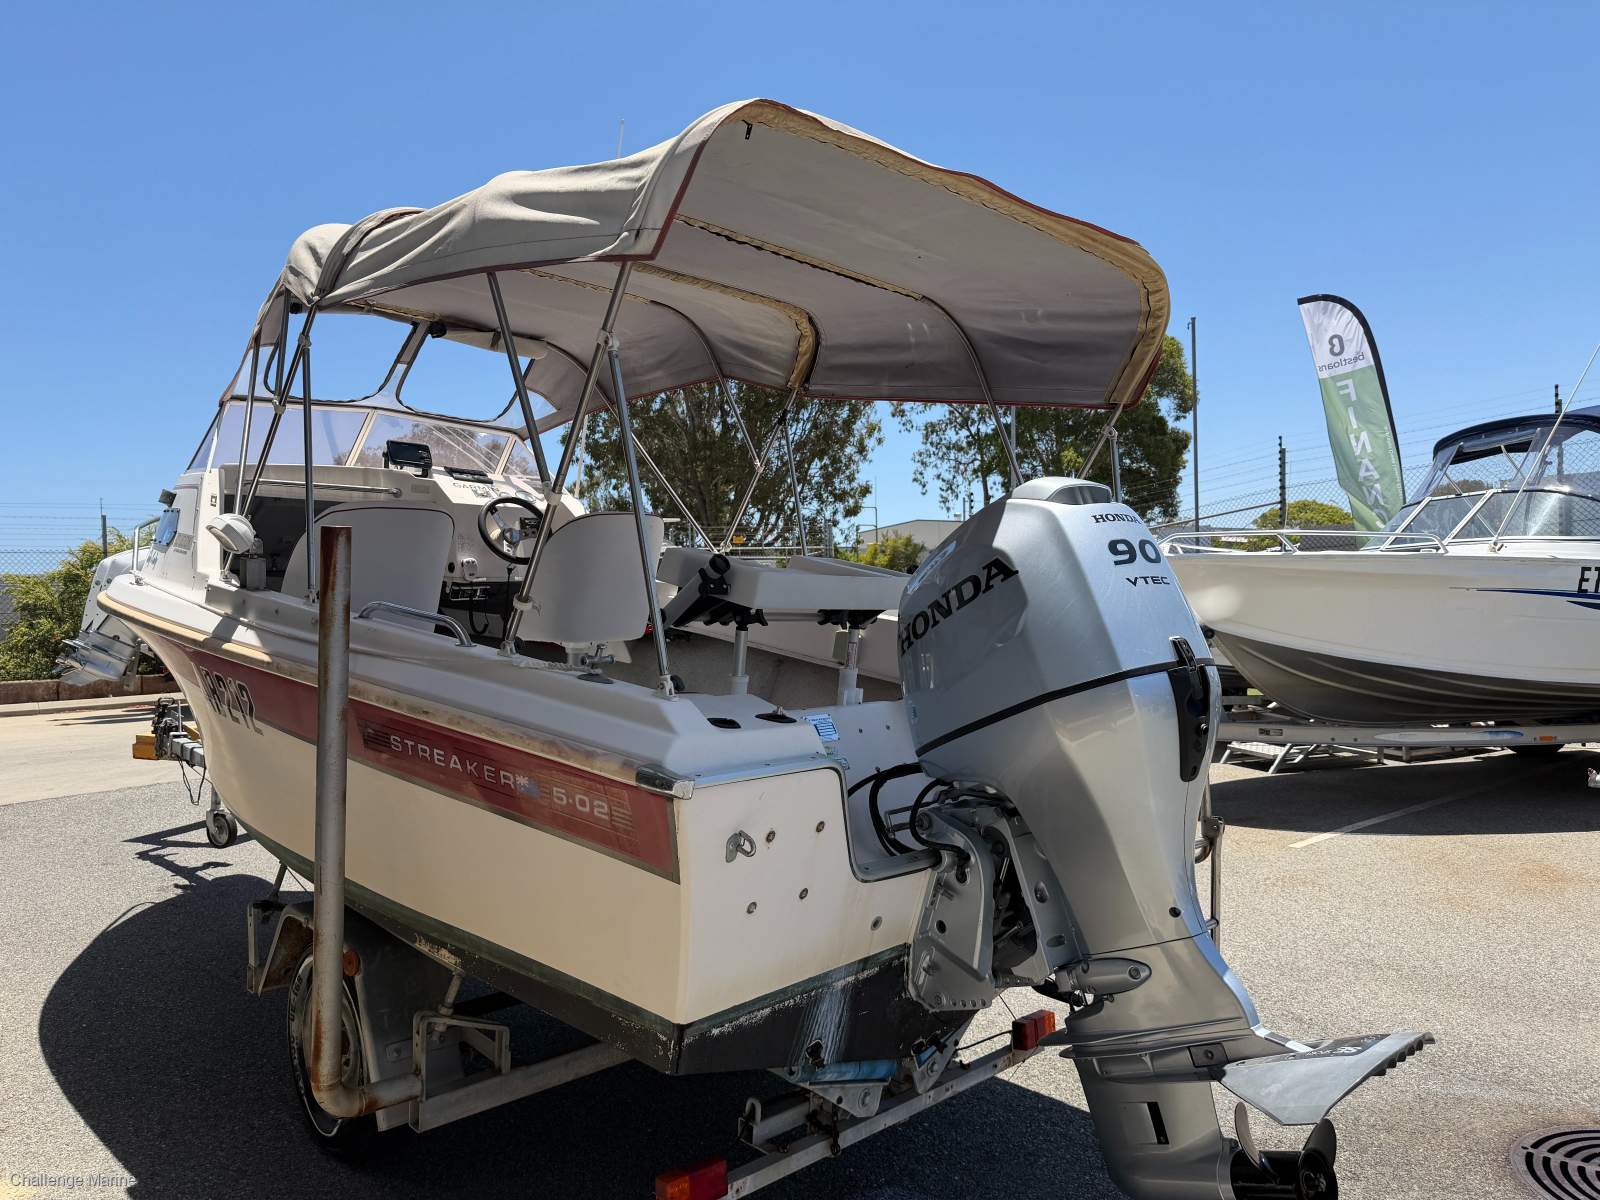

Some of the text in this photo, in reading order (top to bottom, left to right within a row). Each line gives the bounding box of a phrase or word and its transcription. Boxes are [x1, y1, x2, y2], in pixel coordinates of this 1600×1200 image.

[1091, 513, 1142, 524] HONDA
[1107, 538, 1162, 566] 90
[1125, 575, 1170, 587] VTEC
[898, 557, 1019, 657] HONDA
[390, 735, 516, 789] STREAKER
